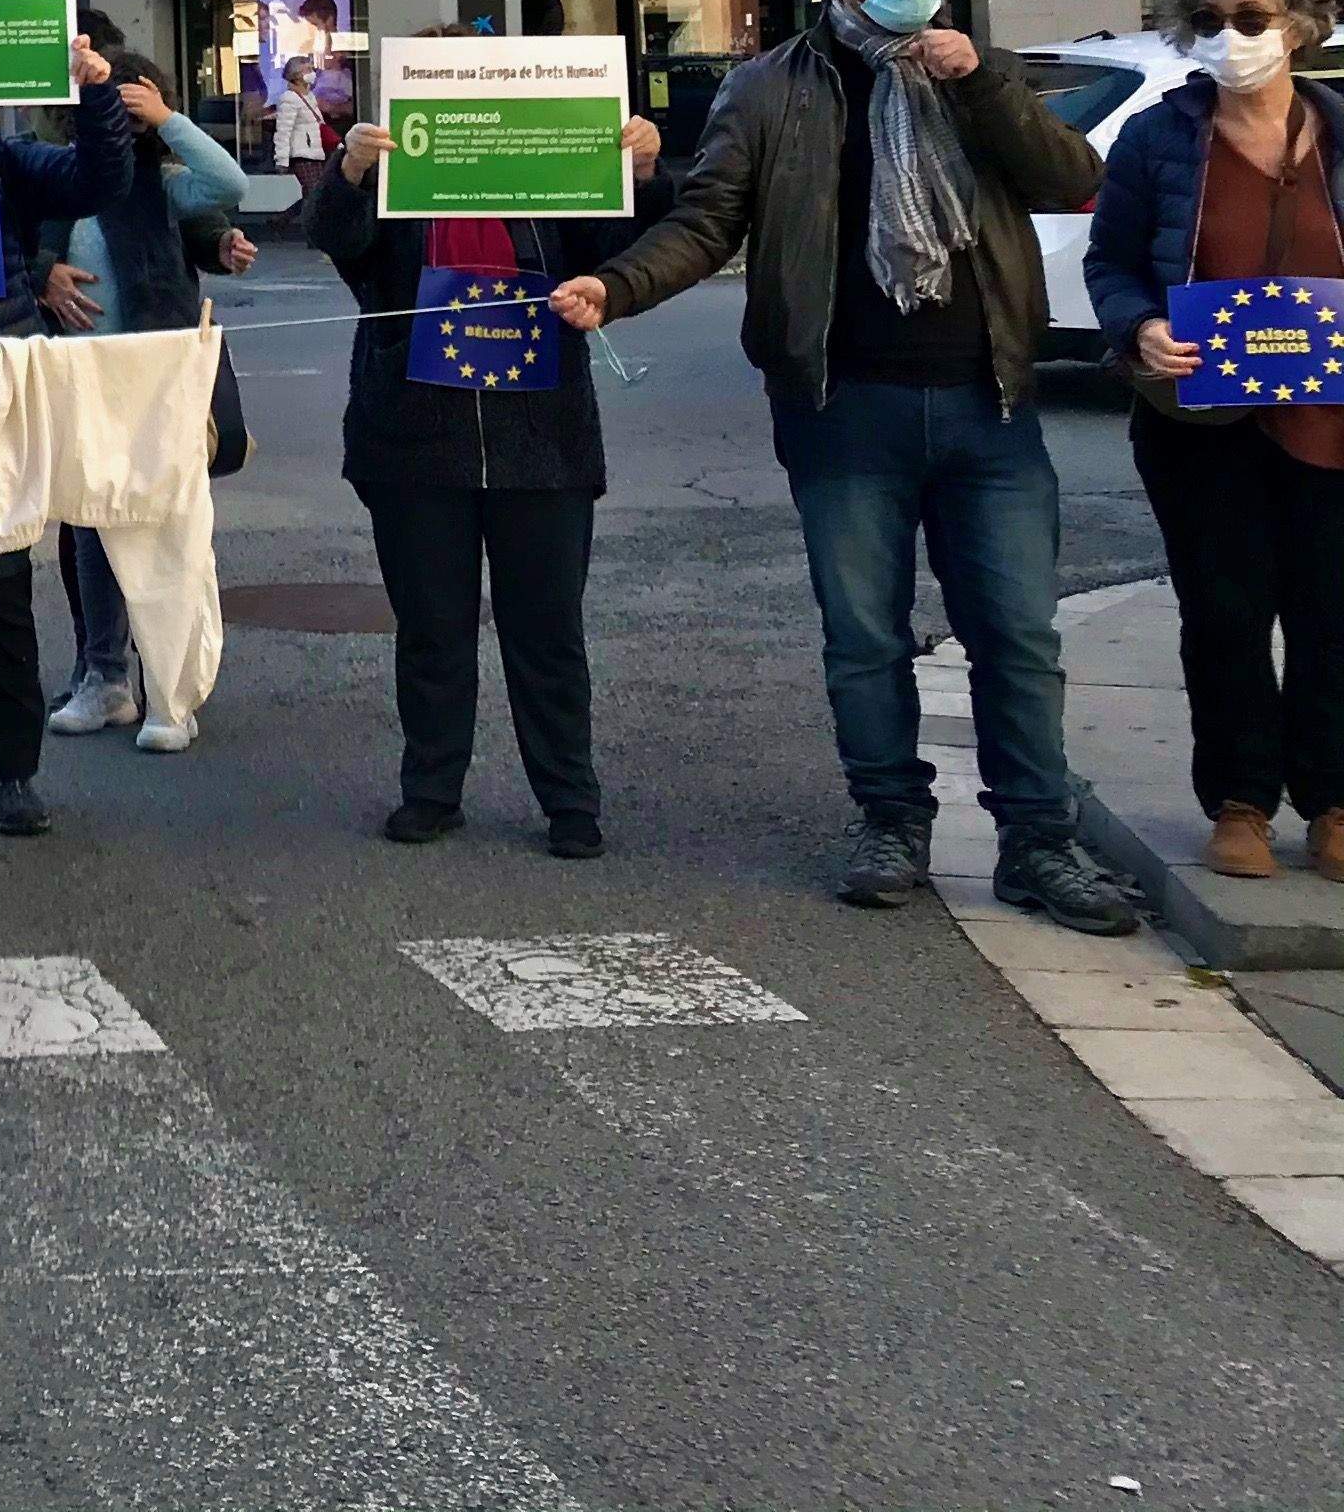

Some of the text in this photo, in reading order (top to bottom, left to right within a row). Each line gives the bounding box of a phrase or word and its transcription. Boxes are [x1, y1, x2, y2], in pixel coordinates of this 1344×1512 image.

[402, 65, 454, 80] Demanem
[478, 66, 516, 80] Europa
[519, 65, 532, 79] de
[535, 64, 563, 78] Drets
[566, 64, 608, 79] Humans!
[435, 110, 501, 125] COOPERACIÓ
[401, 113, 429, 157] 6
[464, 323, 523, 340] BÈLGICA
[1245, 326, 1309, 342] PAÏSOS
[1246, 342, 1312, 355] BAIXOS
